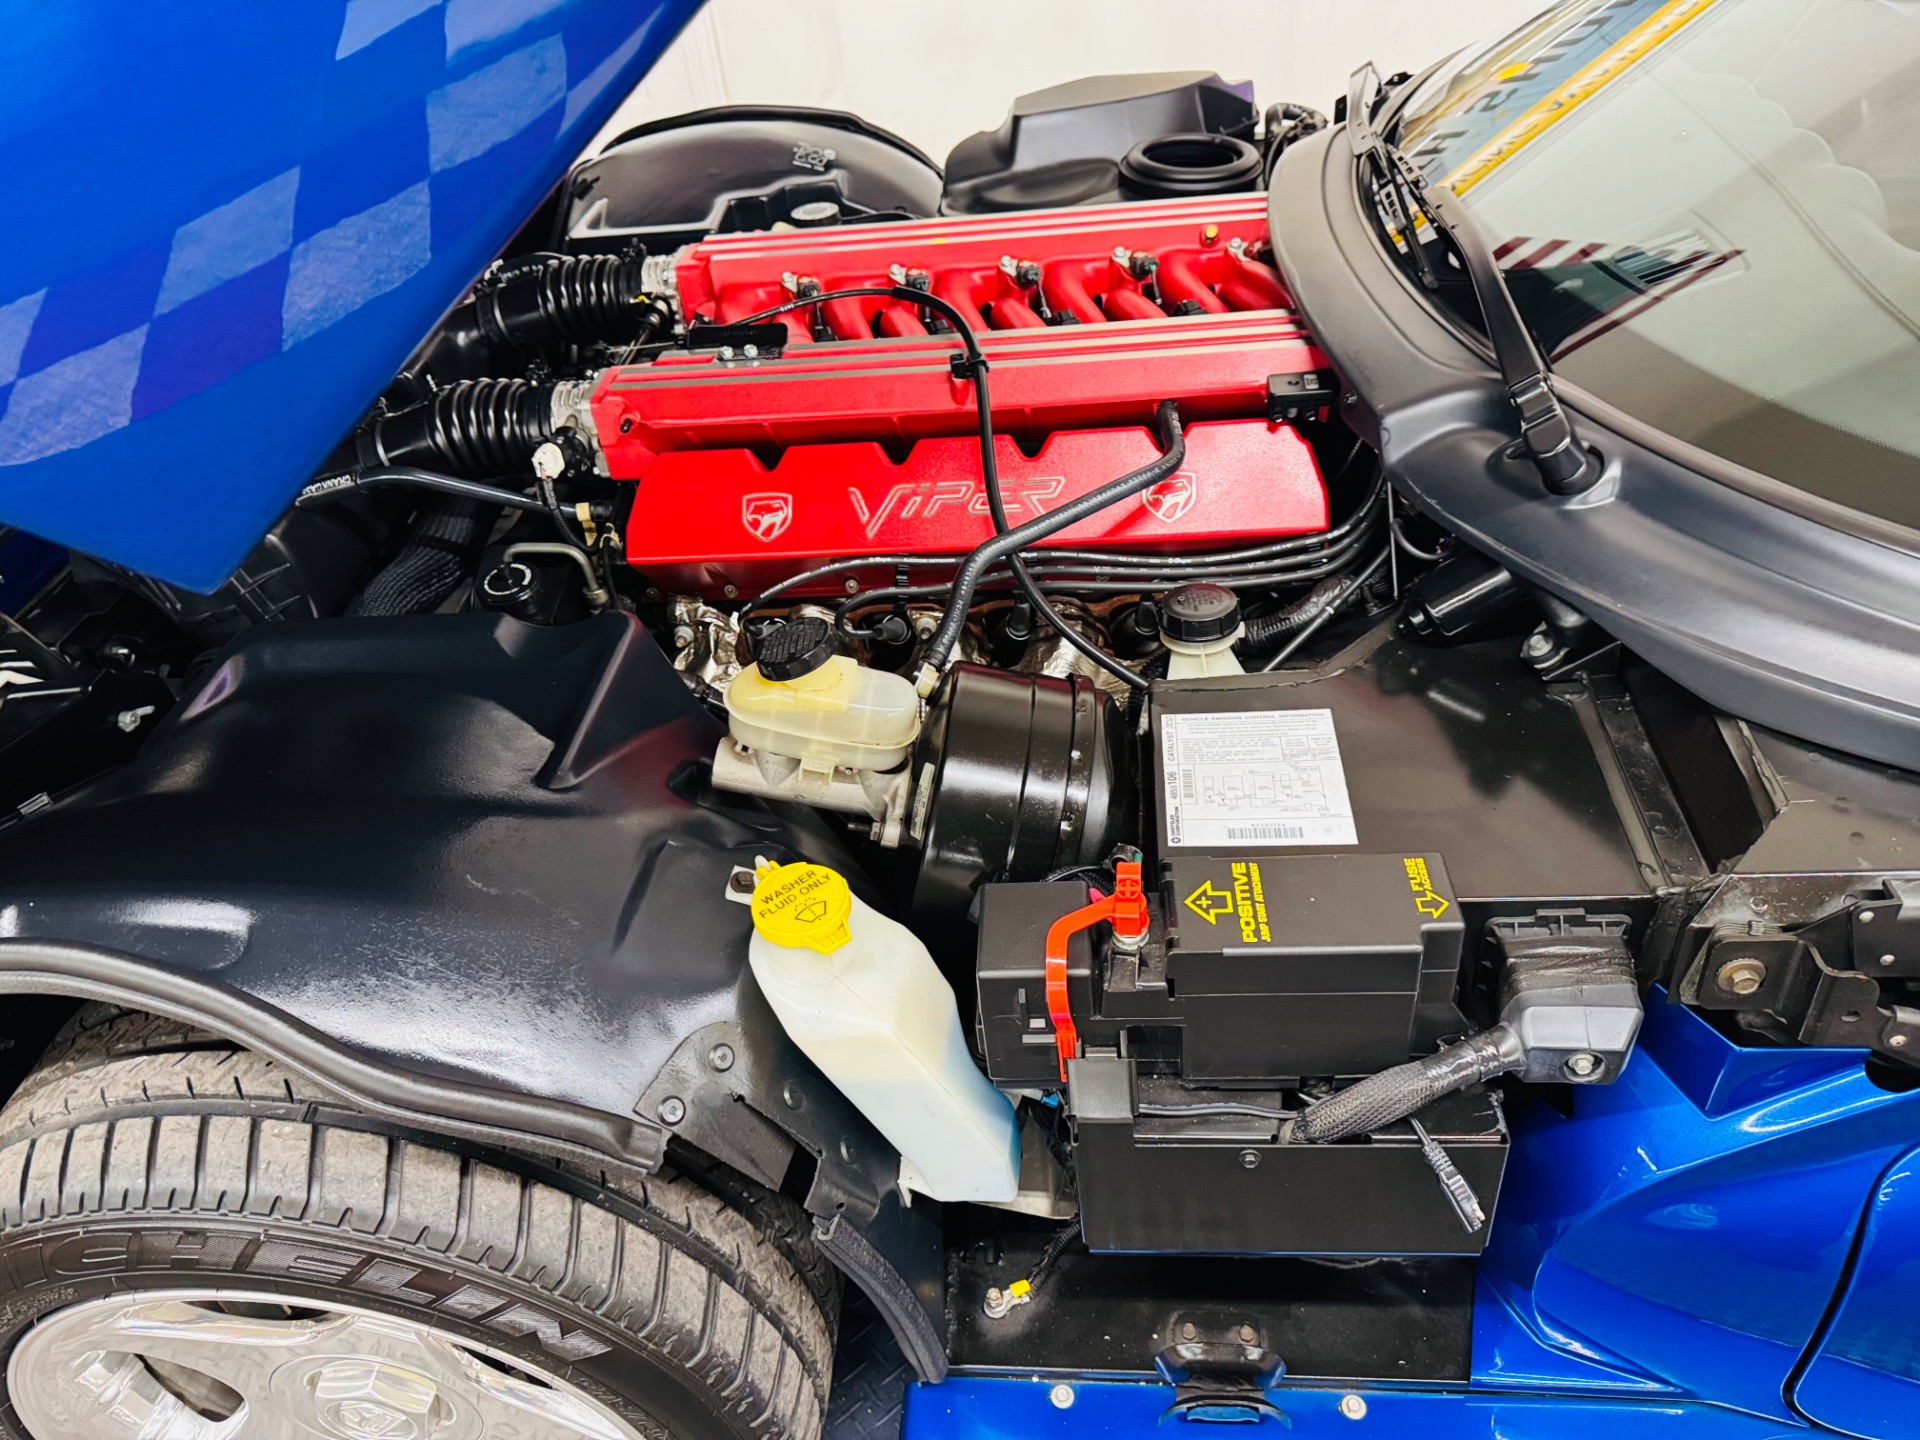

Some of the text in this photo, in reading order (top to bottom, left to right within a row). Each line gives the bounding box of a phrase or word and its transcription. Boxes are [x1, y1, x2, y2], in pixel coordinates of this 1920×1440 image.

[847, 475, 1066, 540] VIPER
[1168, 731, 1176, 761] CATALYST
[759, 873, 831, 919] FLUID ONLY
[760, 869, 817, 905] WASHER
[1403, 857, 1423, 891] FUSE
[1415, 857, 1432, 891] ACCESS
[1231, 862, 1257, 942] POSITIVE
[1249, 862, 1272, 942] JUMP START ATTACHMENT
[0, 1229, 613, 1362] ICHELIN
